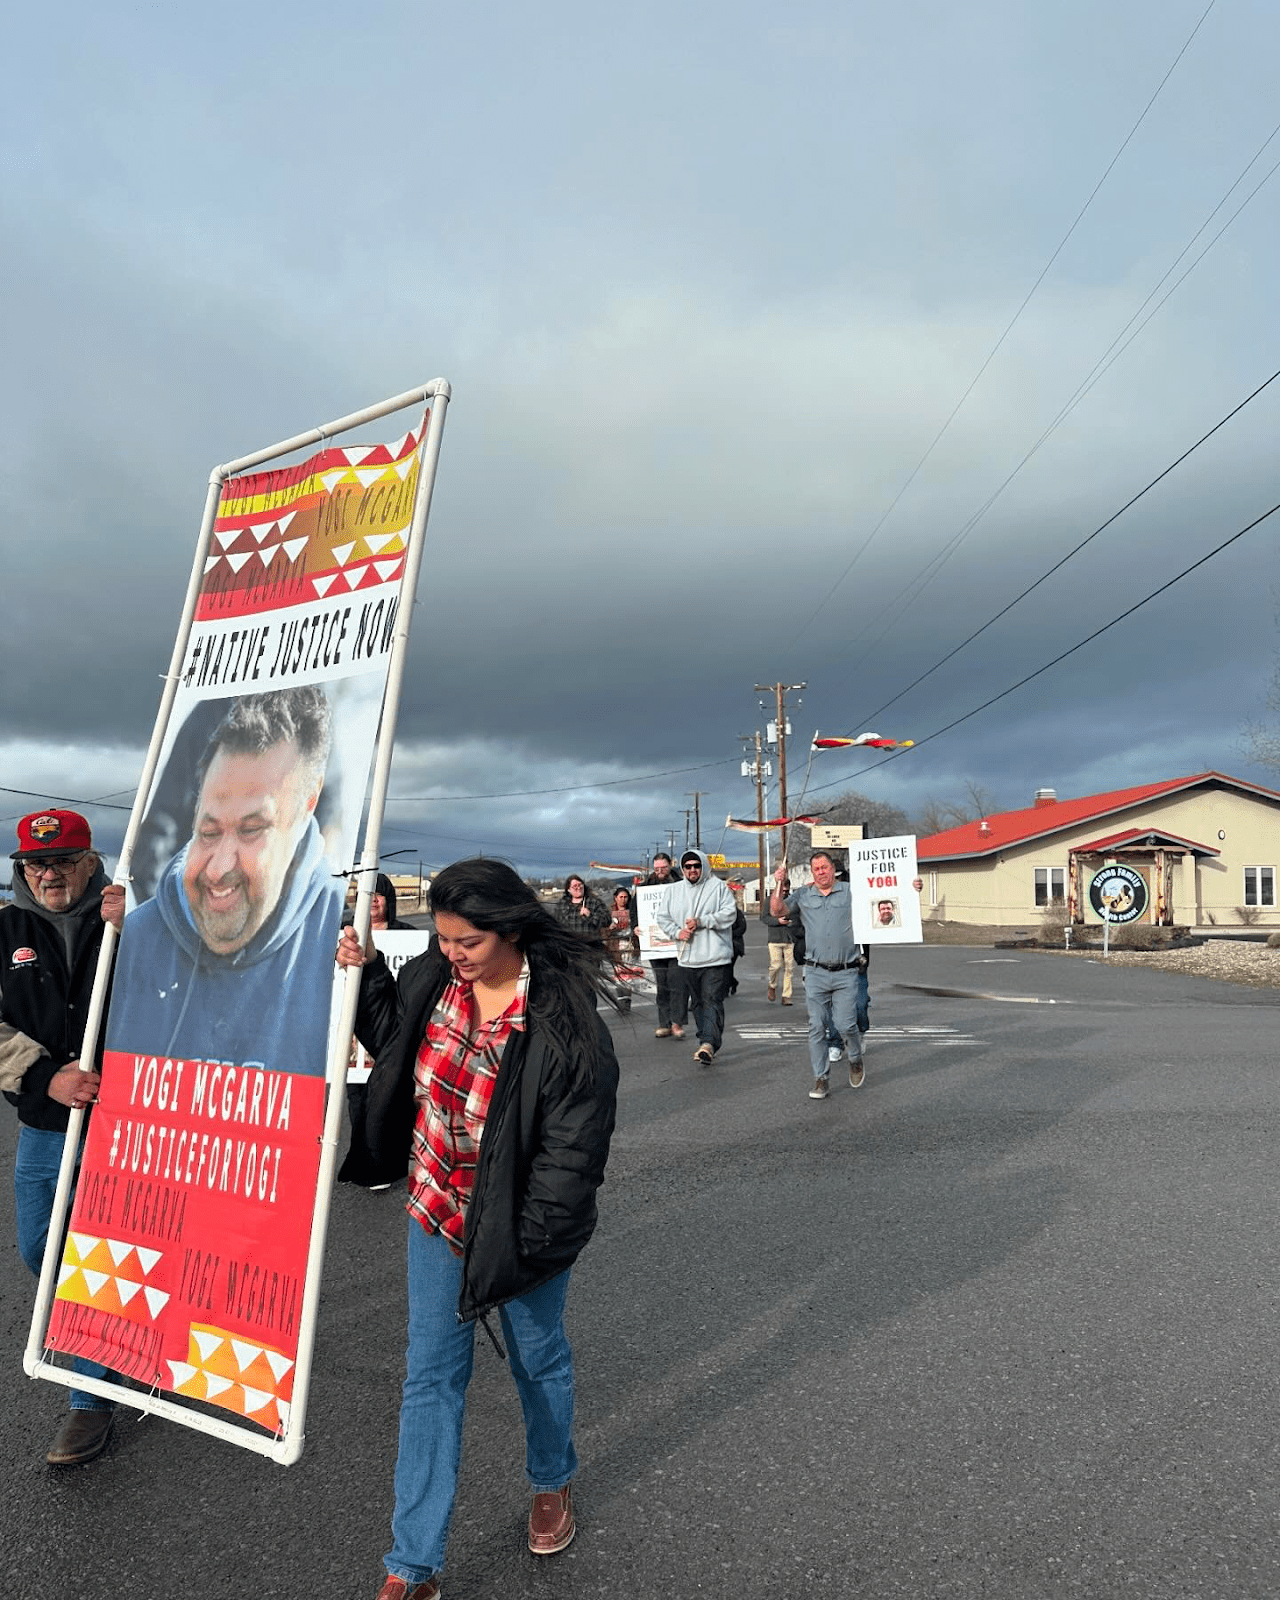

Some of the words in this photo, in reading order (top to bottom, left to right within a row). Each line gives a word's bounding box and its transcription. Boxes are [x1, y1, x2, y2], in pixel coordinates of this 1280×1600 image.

[354, 472, 415, 525] MCGAR
[185, 626, 270, 688] #NATIVE
[270, 607, 352, 678] JUSTICE
[352, 595, 398, 660] NOW
[857, 847, 908, 861] JUSTICE
[867, 876, 898, 888] YOGI
[871, 862, 895, 873] FOR
[1117, 867, 1142, 888] Family
[130, 1056, 184, 1112] YOGI
[190, 1064, 292, 1131] MCGARVA
[109, 1119, 282, 1203] #JUSTICEFORYOGI
[79, 1170, 118, 1225] YOGI
[121, 1178, 188, 1244] MCGARVA
[179, 1248, 220, 1310] YOGI
[226, 1261, 298, 1337] MCGARVA
